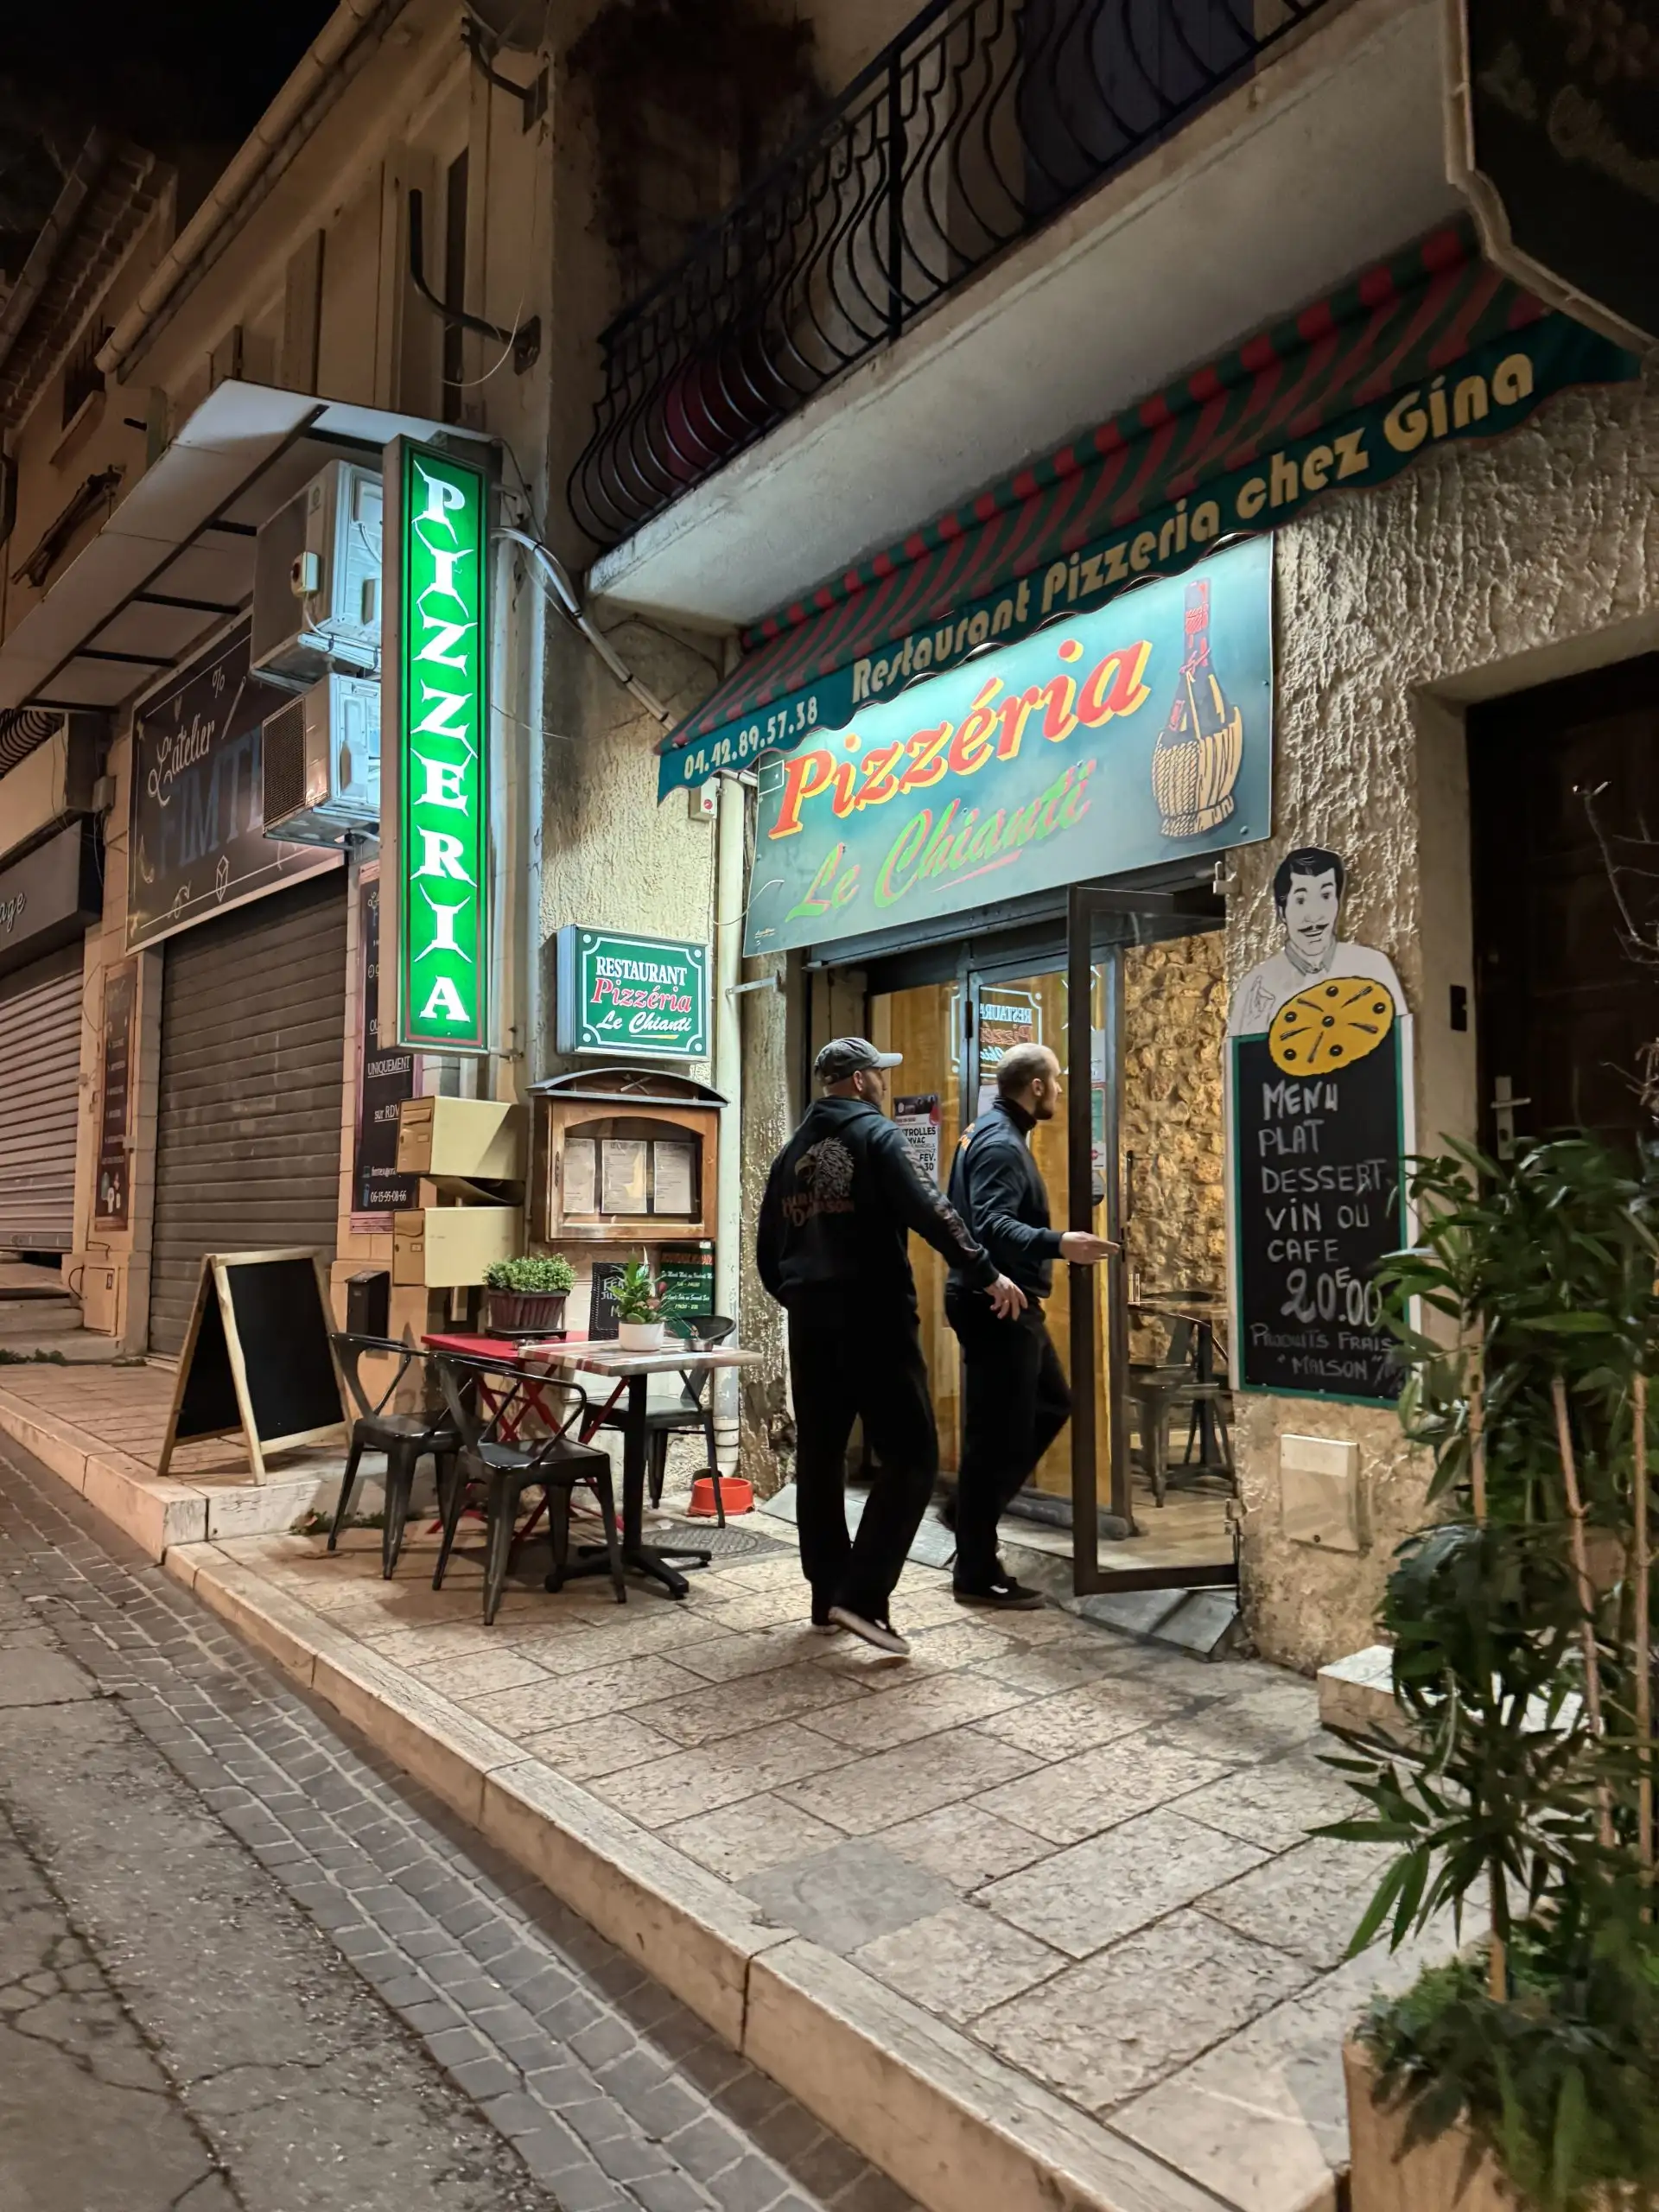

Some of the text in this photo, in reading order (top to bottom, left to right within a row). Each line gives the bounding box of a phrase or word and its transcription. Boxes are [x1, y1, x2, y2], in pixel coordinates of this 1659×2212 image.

[851, 353, 1535, 703] Restaurant Pizzeria chez Gina
[410, 460, 479, 1022] PIZZERIA
[768, 639, 1152, 840] Pizzéria
[148, 713, 215, 808] L'atelier
[785, 760, 1097, 922] Le Chianti
[595, 957, 688, 986] RESTAURANT
[590, 977, 692, 1013] Pizzéria
[596, 1010, 692, 1033] Le Chianti
[367, 1056, 410, 1076] UNIQUEMENT
[374, 1109, 385, 1120] sur
[1262, 1079, 1338, 1121] MENU
[1258, 1119, 1325, 1157] PLAT
[1262, 1159, 1387, 1194] DESSERT
[1338, 1203, 1370, 1229] OU
[1267, 1239, 1339, 1262] CAFE
[1338, 1332, 1393, 1352] FRAIS
